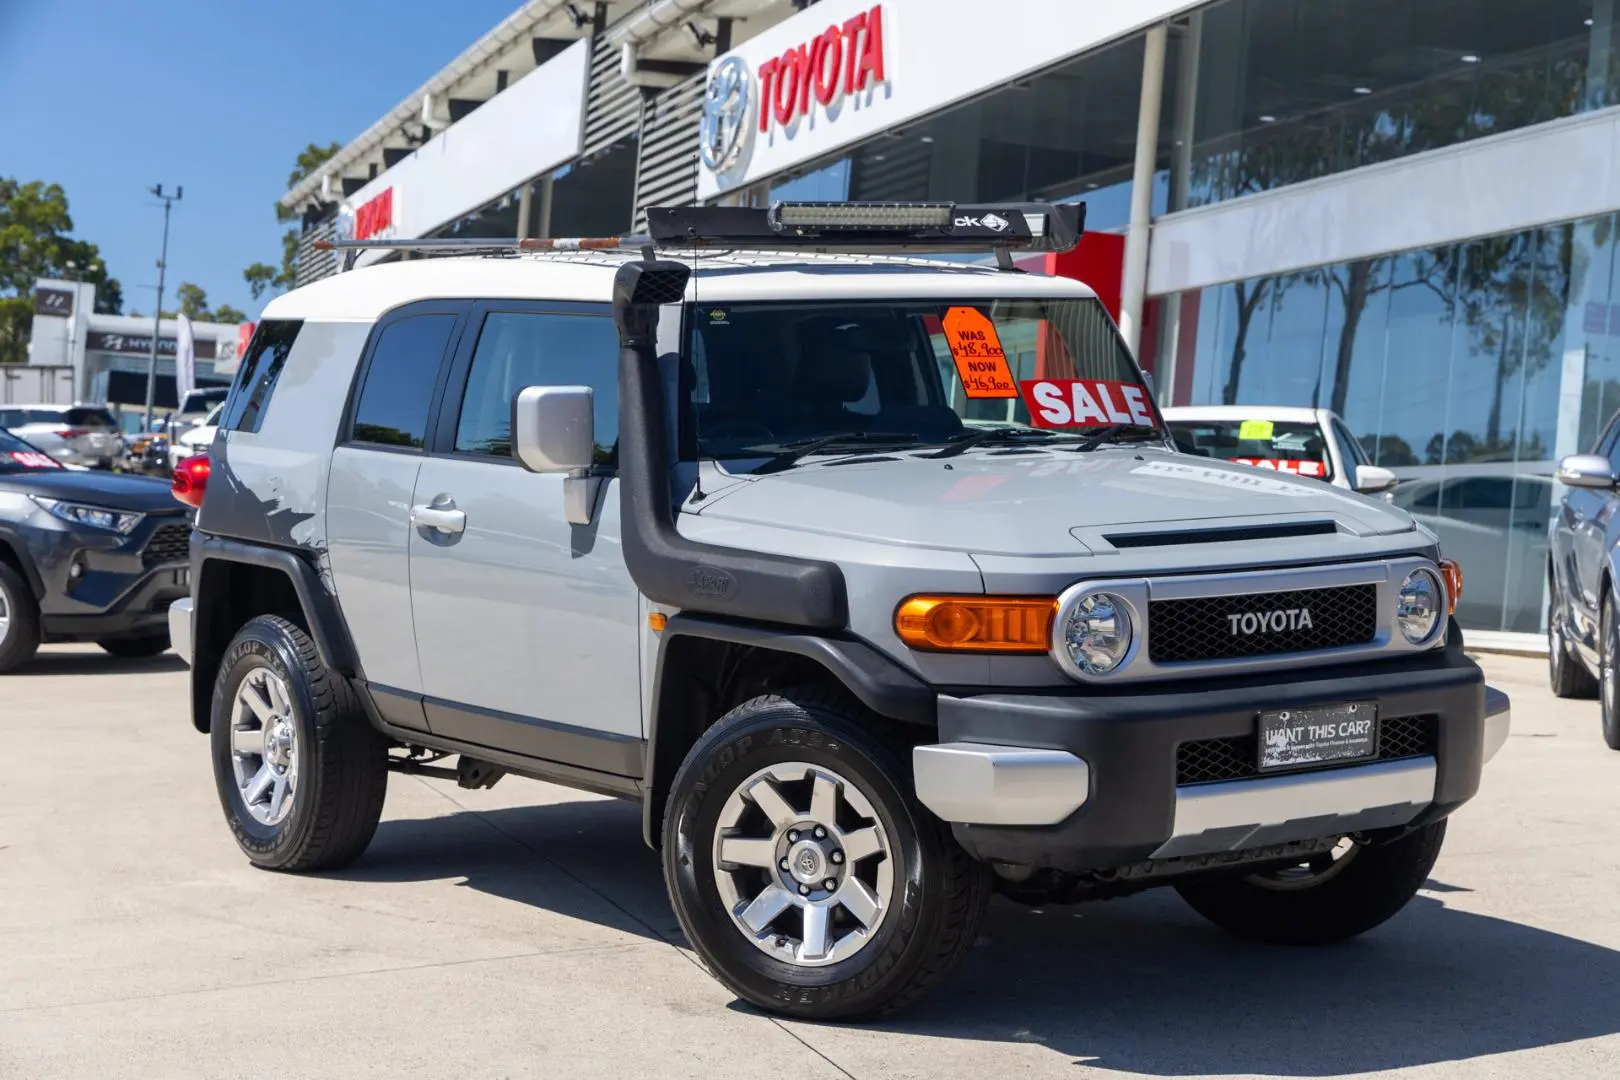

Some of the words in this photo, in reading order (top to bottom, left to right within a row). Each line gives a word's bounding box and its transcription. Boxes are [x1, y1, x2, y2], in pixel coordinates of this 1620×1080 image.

[758, 4, 884, 133] TOYOTA
[958, 330, 986, 341] WAS
[967, 361, 997, 372] NOW
[1032, 381, 1154, 427] SALE
[1227, 608, 1314, 636] TOYOTA
[1265, 726, 1304, 746] WANT
[1307, 723, 1336, 740] THIS
[1338, 719, 1371, 737] CAR?
